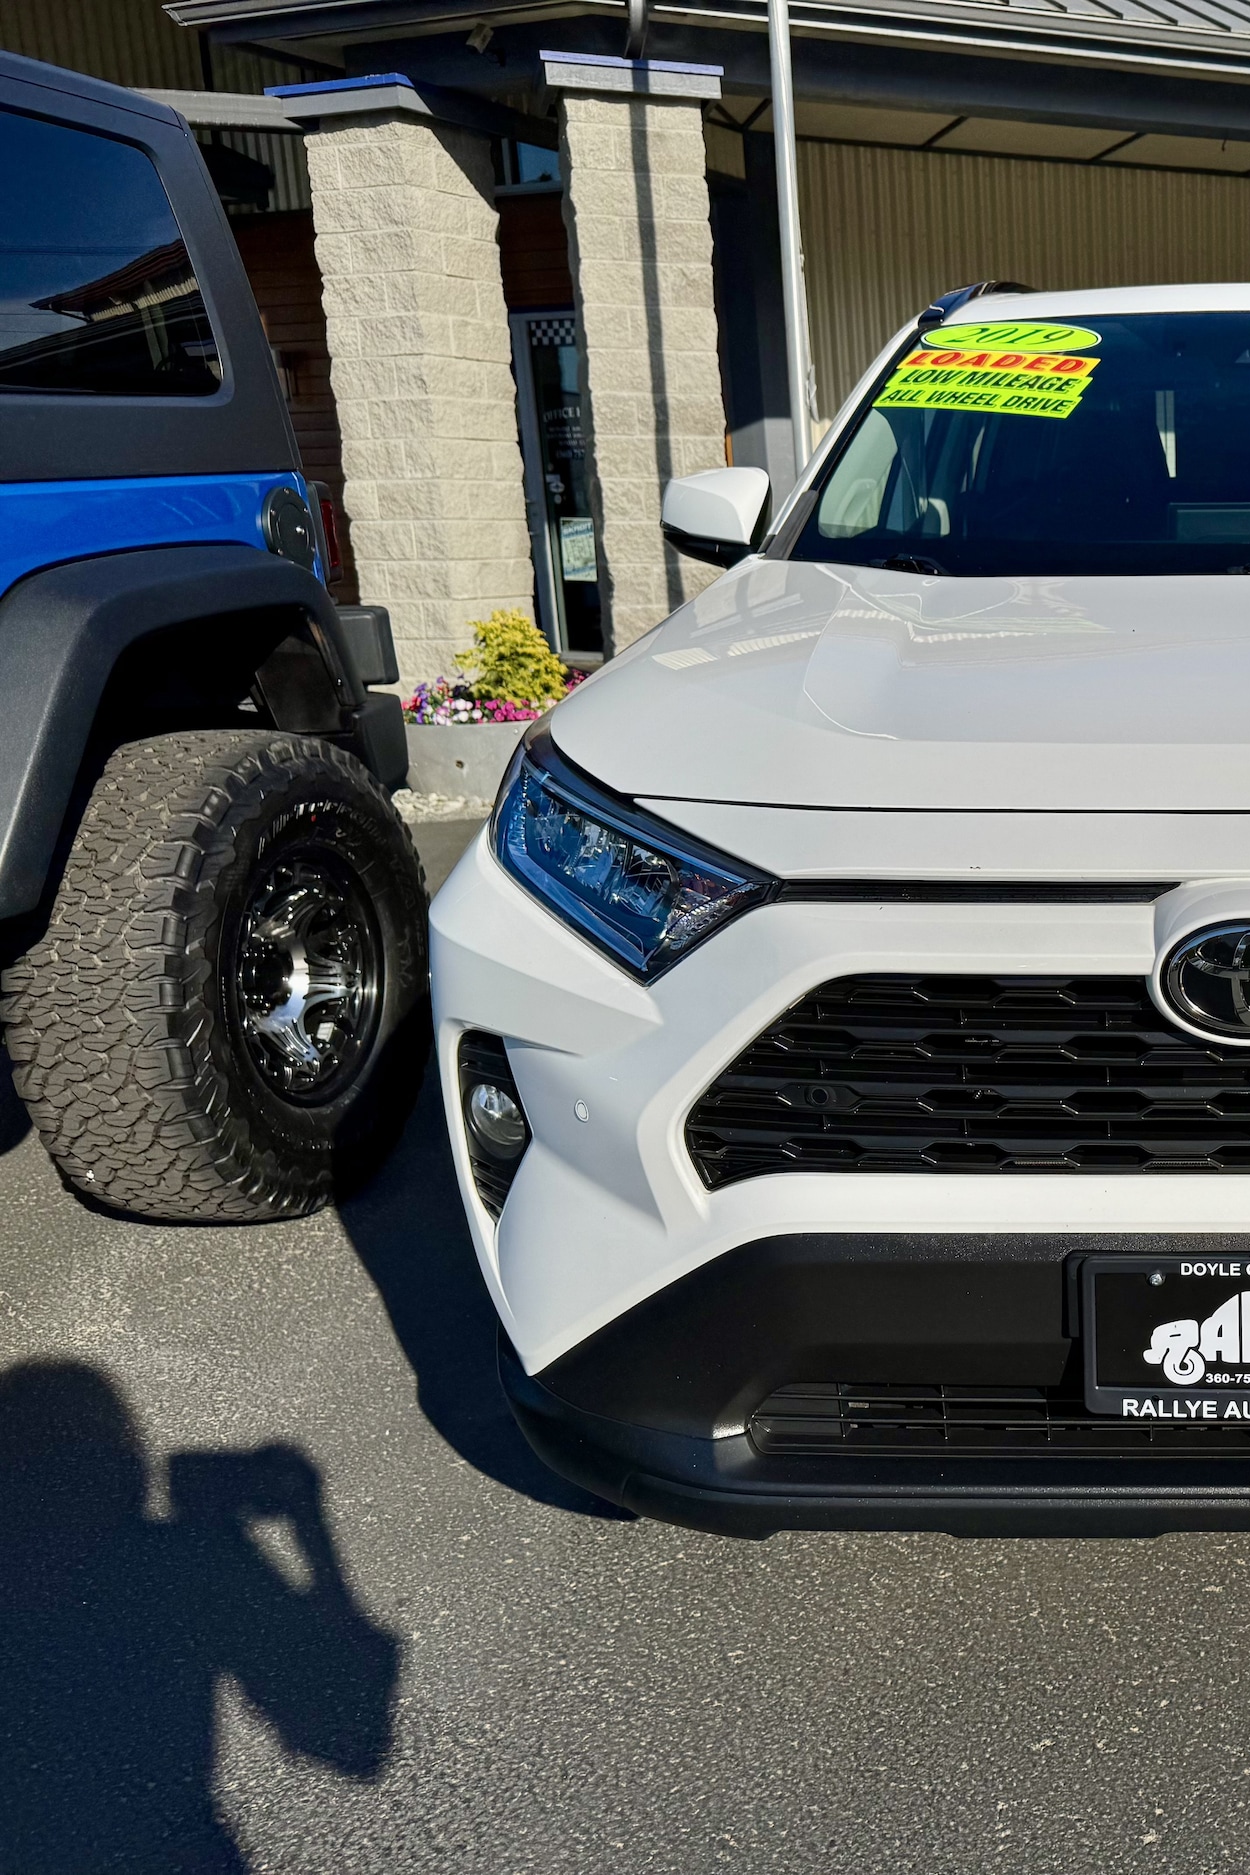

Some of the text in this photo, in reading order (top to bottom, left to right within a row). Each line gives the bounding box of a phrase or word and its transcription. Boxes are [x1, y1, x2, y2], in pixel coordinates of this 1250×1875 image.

[943, 327, 1075, 346] 2019
[906, 351, 1087, 373] LOADED
[899, 368, 1082, 395] LOW MILEAGE
[880, 389, 1076, 413] ALL WHEEL DRIVE
[1180, 1262, 1242, 1277] DOYLE
[1122, 1399, 1218, 1418] RALLYE
